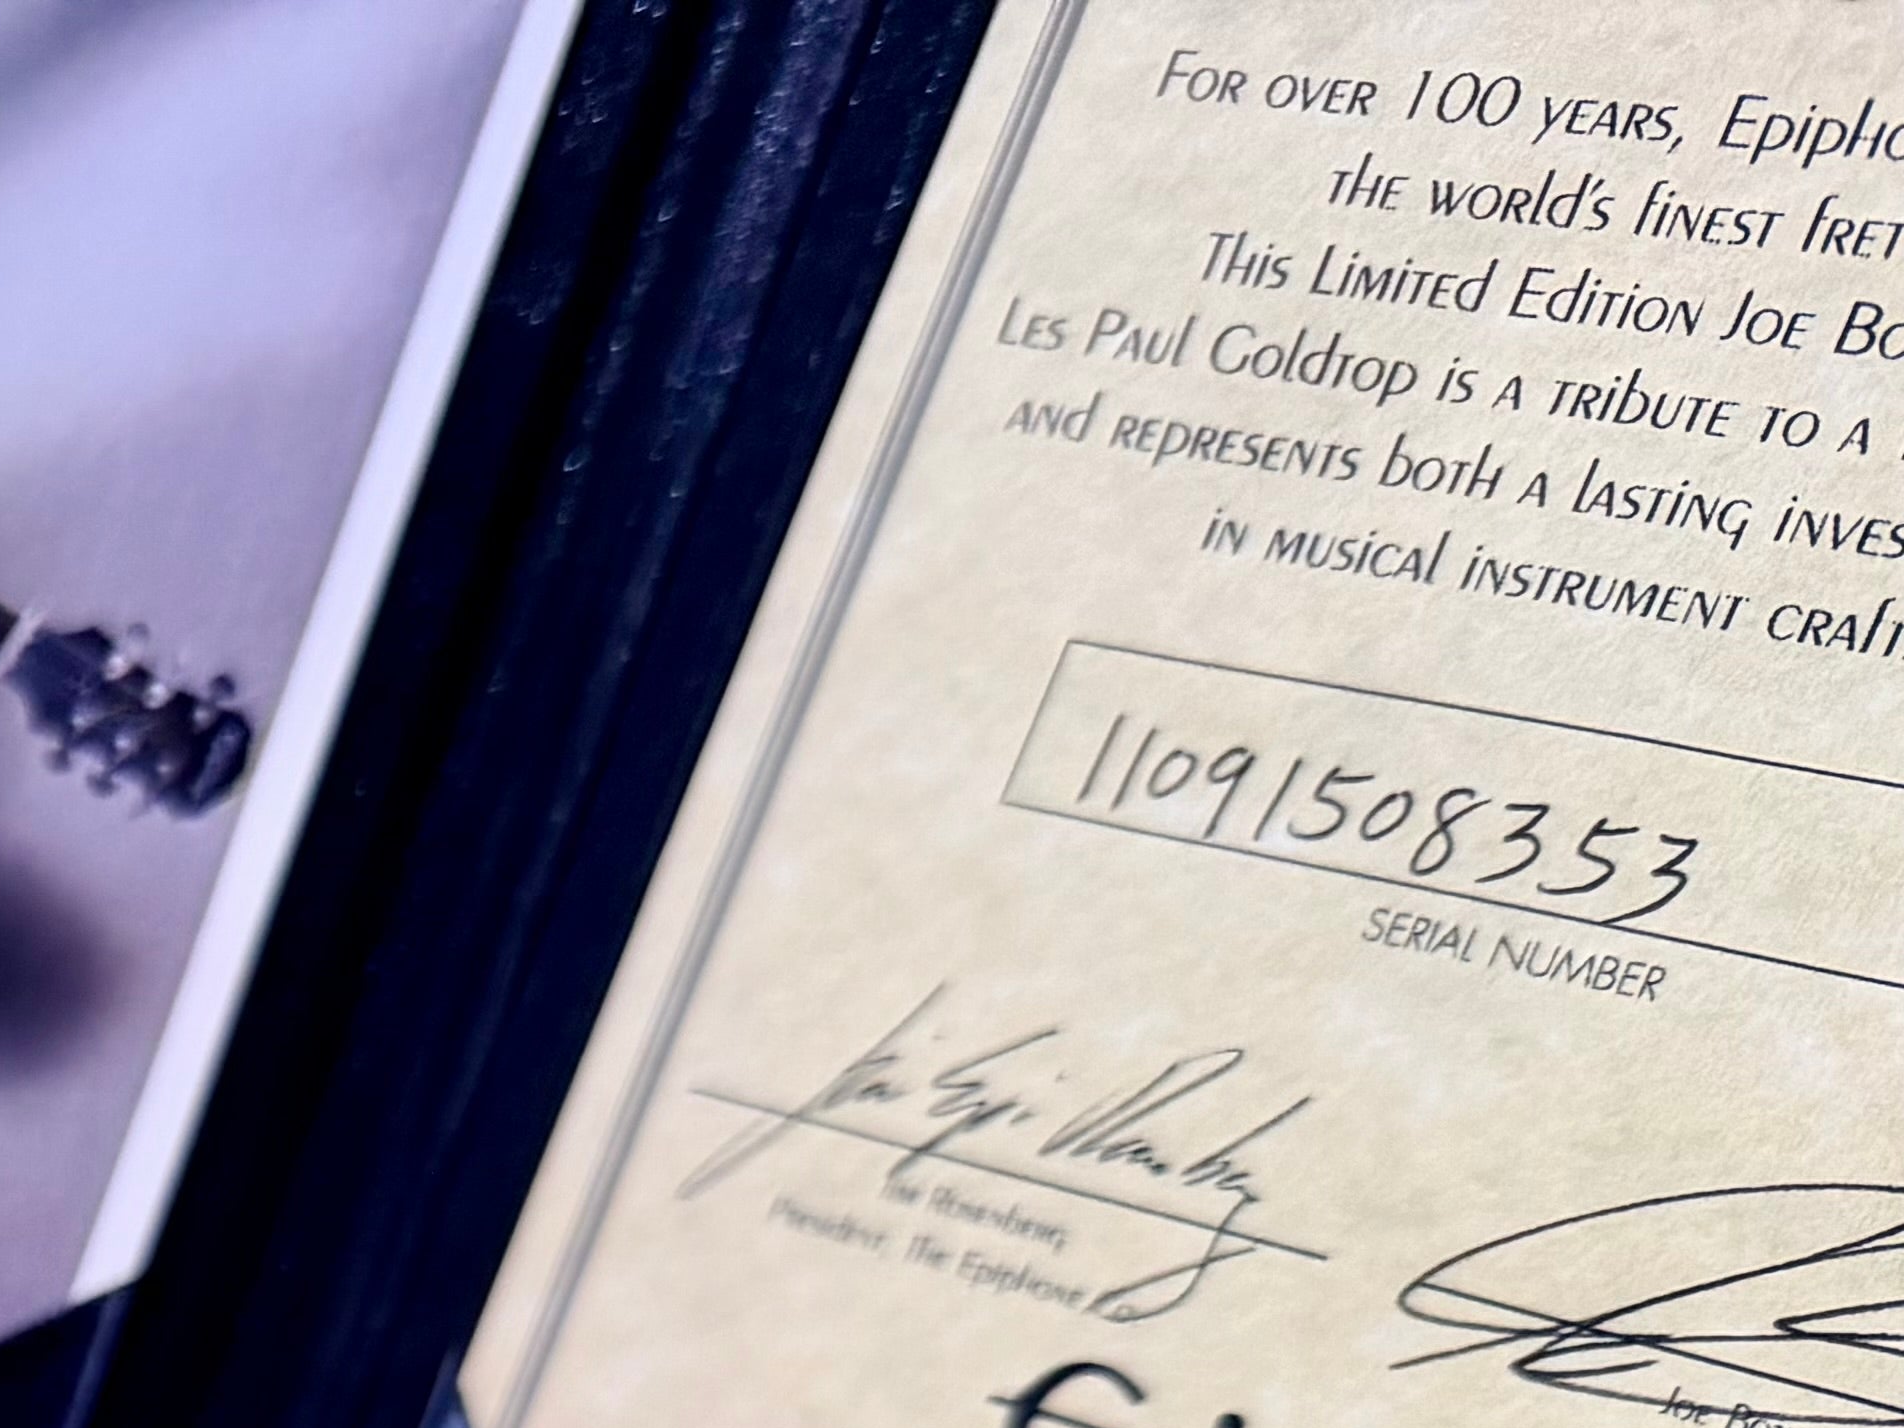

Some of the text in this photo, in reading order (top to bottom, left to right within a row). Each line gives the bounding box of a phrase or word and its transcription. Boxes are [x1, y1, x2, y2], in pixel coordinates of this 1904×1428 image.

[1405, 66, 1523, 128] 100
[1075, 712, 1699, 926] 11091508353
[1362, 907, 1667, 1003] SERIAL NUMBER
